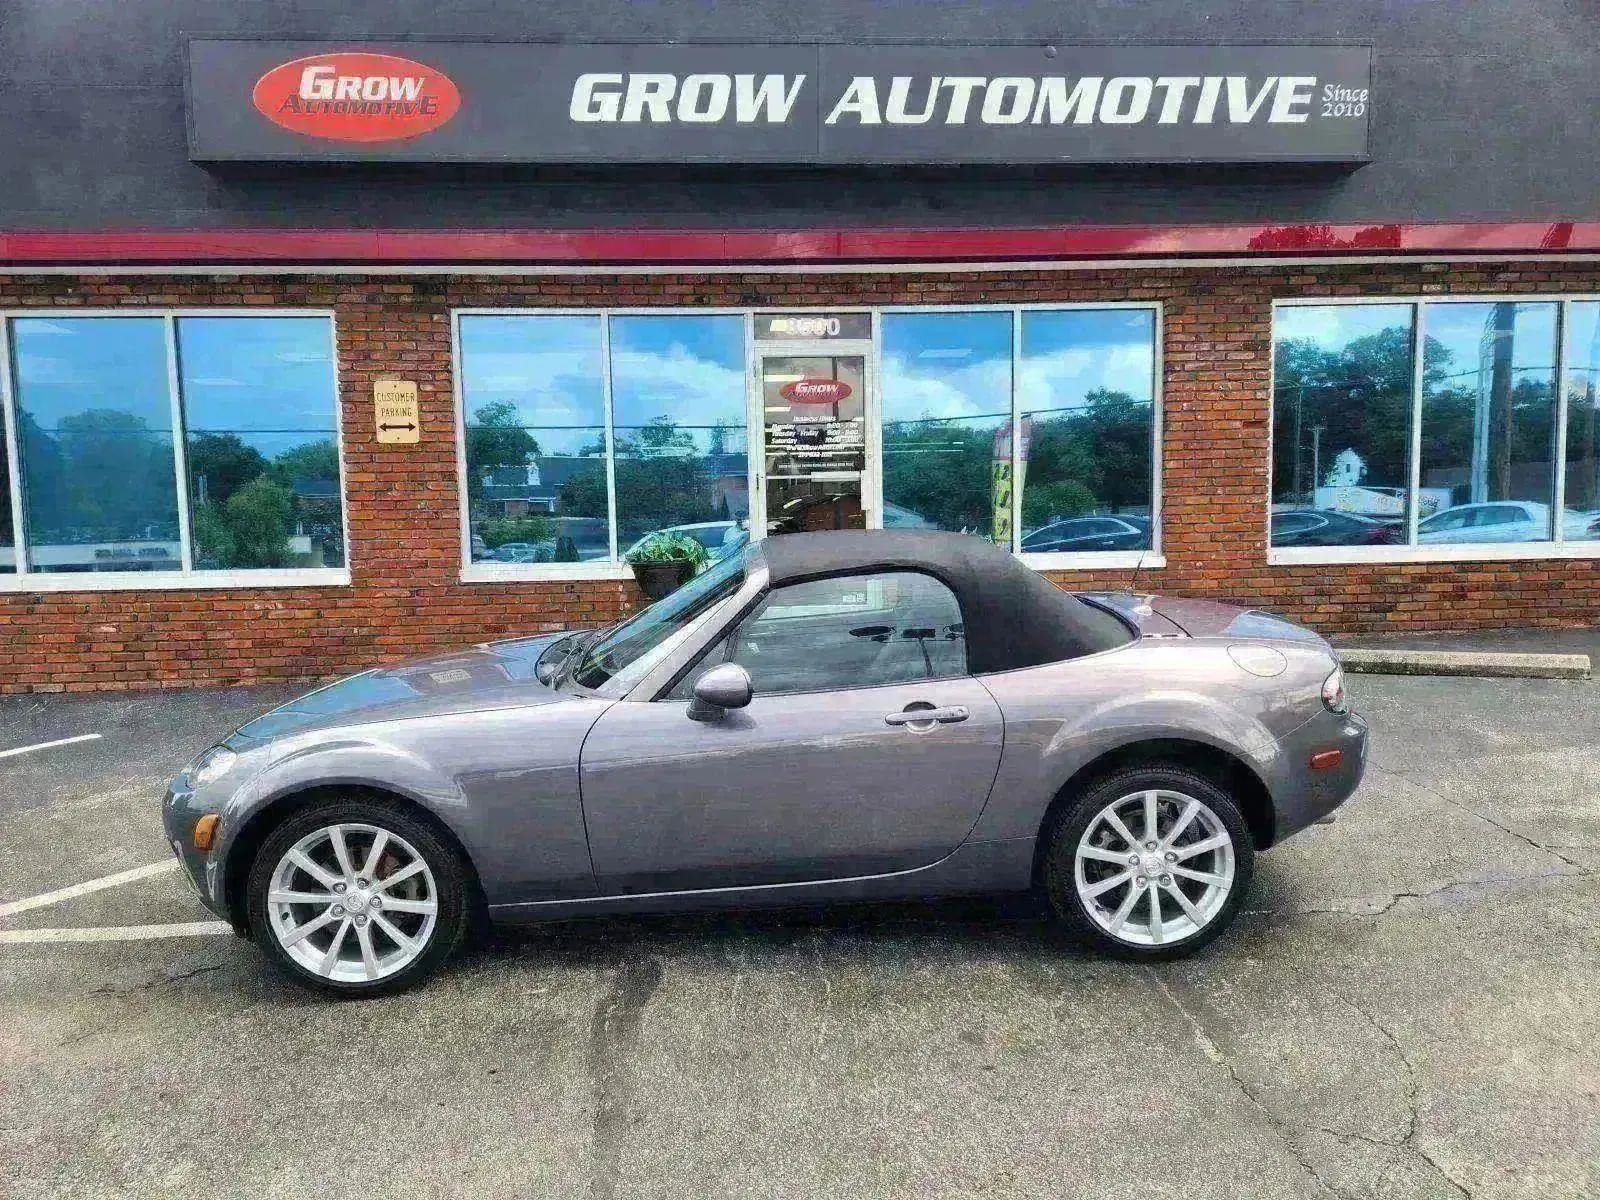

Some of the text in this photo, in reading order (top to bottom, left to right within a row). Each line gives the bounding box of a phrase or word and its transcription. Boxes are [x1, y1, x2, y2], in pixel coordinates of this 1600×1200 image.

[298, 66, 426, 101] GROW
[569, 73, 1319, 125] GROW AUTOMOTIVE
[1321, 84, 1370, 103] Since
[276, 94, 440, 117] AUTOMOTIVE
[1320, 102, 1365, 118] 2010
[794, 382, 839, 393] GROW
[376, 392, 415, 402] CUSTOMER
[381, 407, 413, 417] PARKING
[771, 437, 798, 445] Saturday
